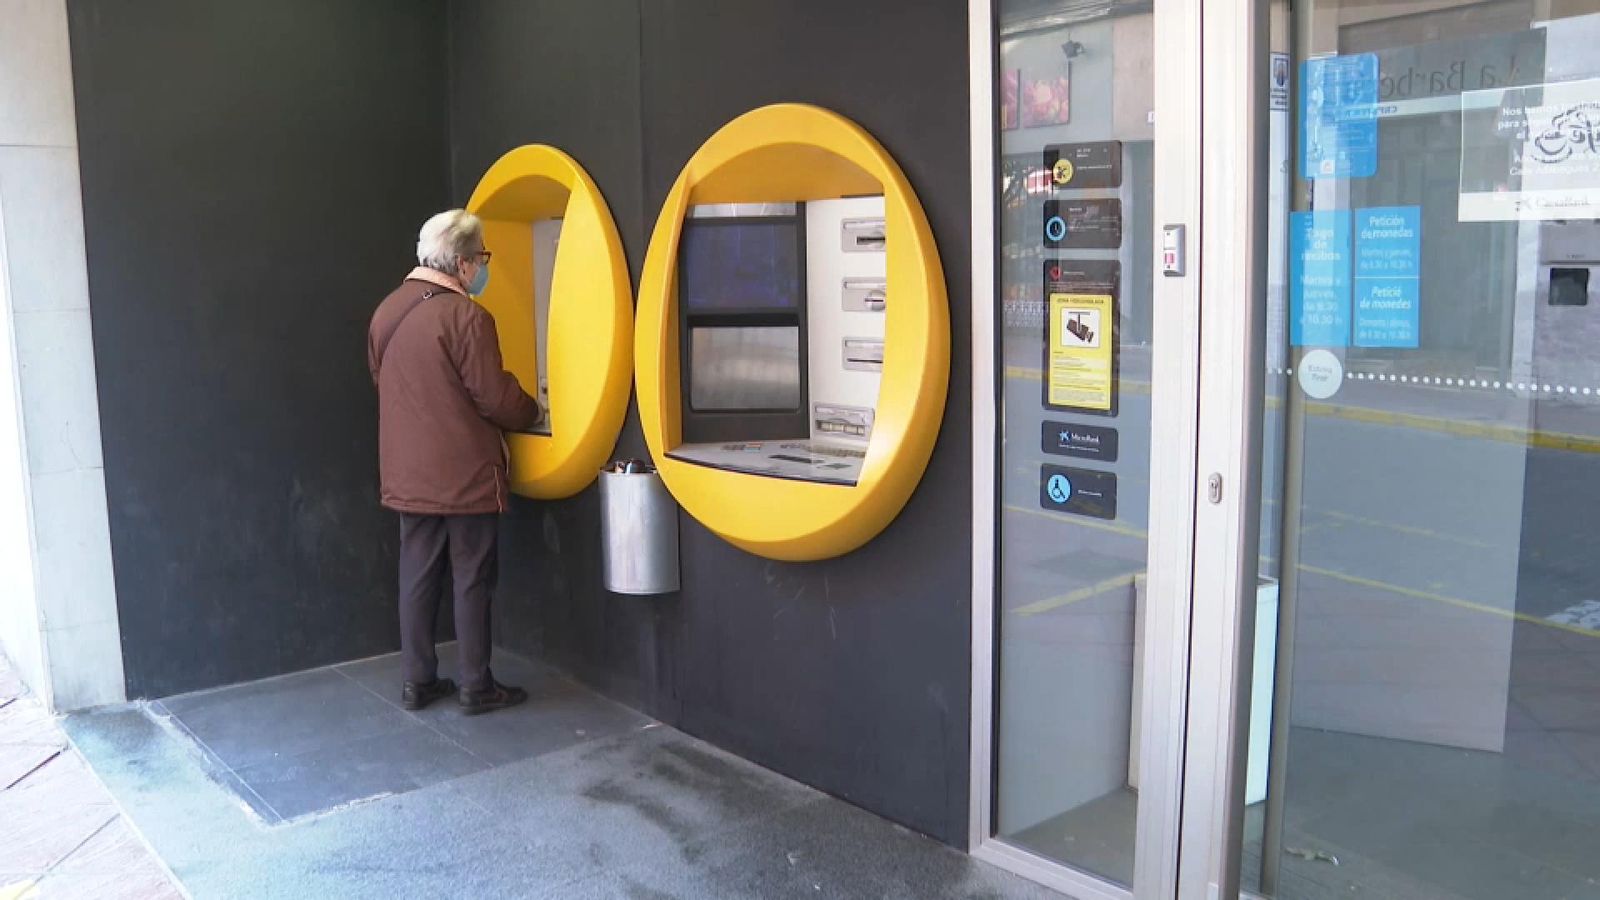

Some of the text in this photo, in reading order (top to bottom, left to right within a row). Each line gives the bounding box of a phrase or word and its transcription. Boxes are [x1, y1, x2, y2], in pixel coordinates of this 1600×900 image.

[1369, 214, 1405, 227] Petición
[1373, 227, 1414, 239] monedas
[1313, 239, 1328, 249] de
[1371, 286, 1402, 299] Petició
[1360, 297, 1412, 309] de monedes
